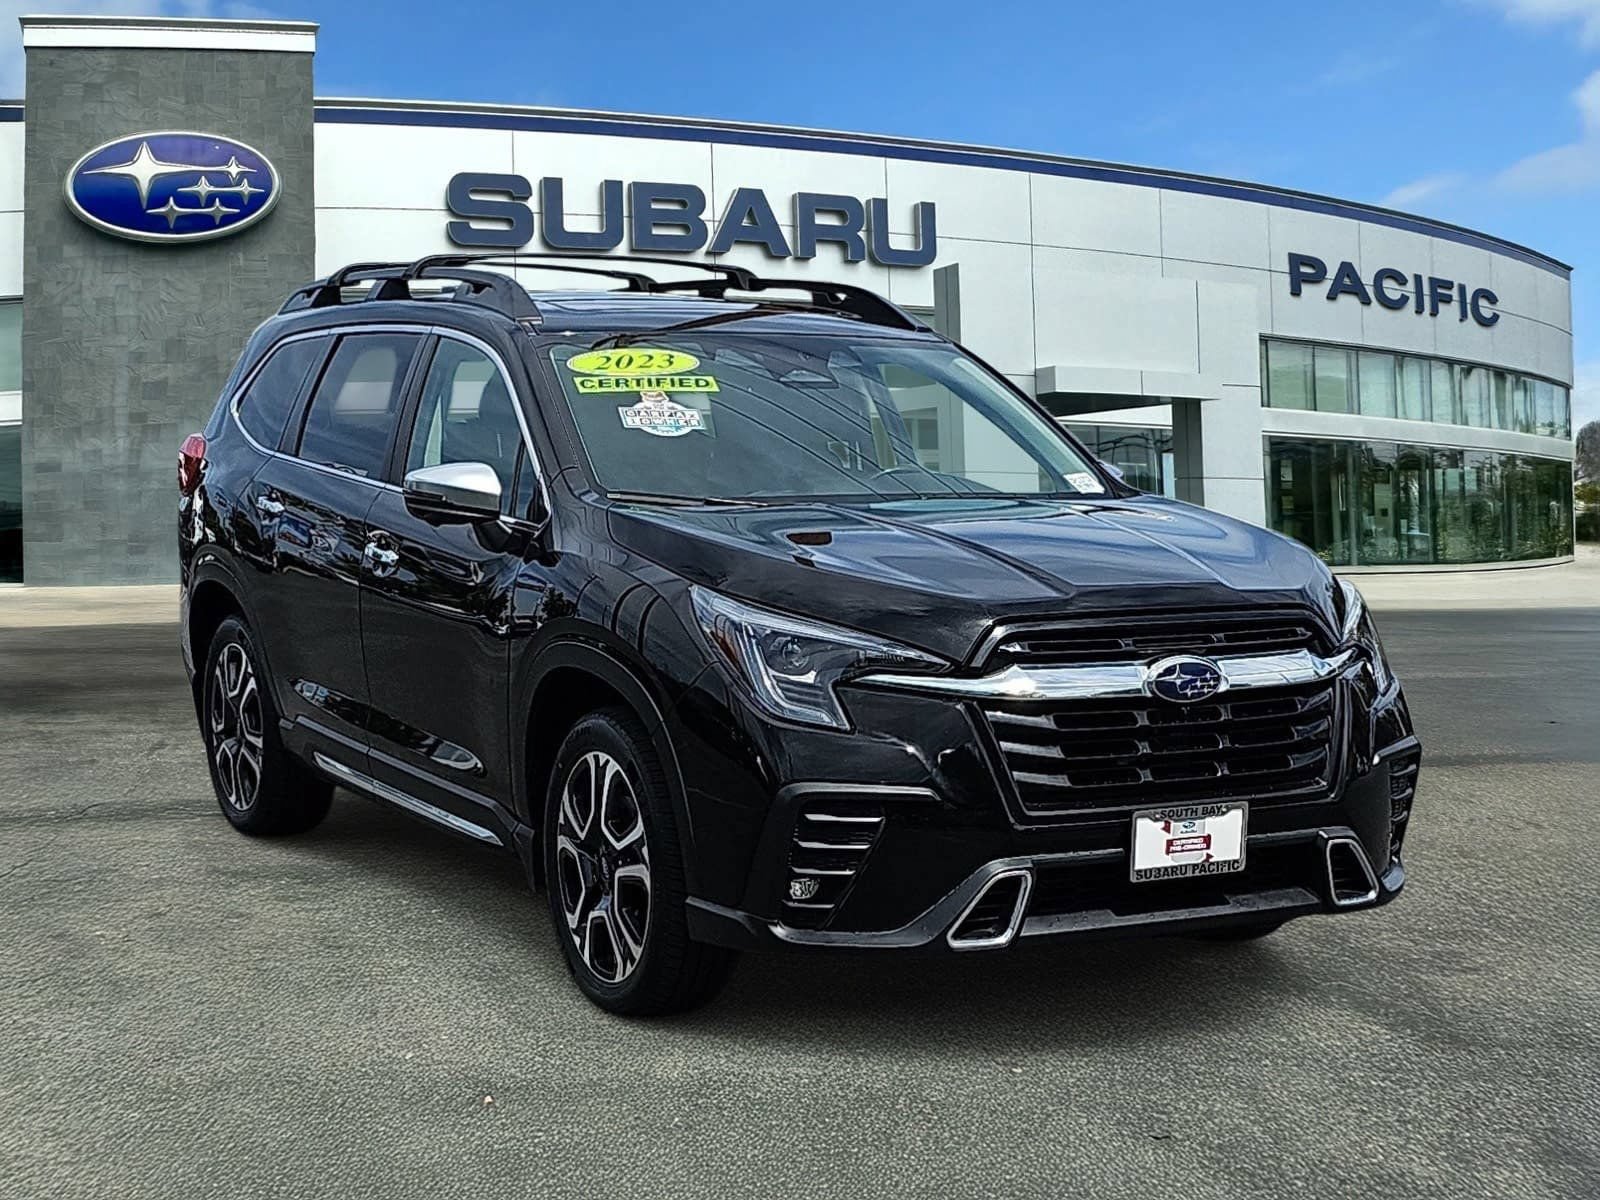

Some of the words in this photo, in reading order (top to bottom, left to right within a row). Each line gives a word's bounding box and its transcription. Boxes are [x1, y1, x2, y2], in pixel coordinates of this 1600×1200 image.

[446, 171, 937, 268] SUBARU
[1287, 251, 1501, 328] PACIFIC
[594, 352, 675, 371] 2023
[579, 377, 710, 390] CERTIFIED
[1160, 807, 1199, 819] SOUTH
[1202, 804, 1223, 816] BAY
[1135, 865, 1188, 880] SUBARU
[1192, 860, 1241, 875] PACIFIC
